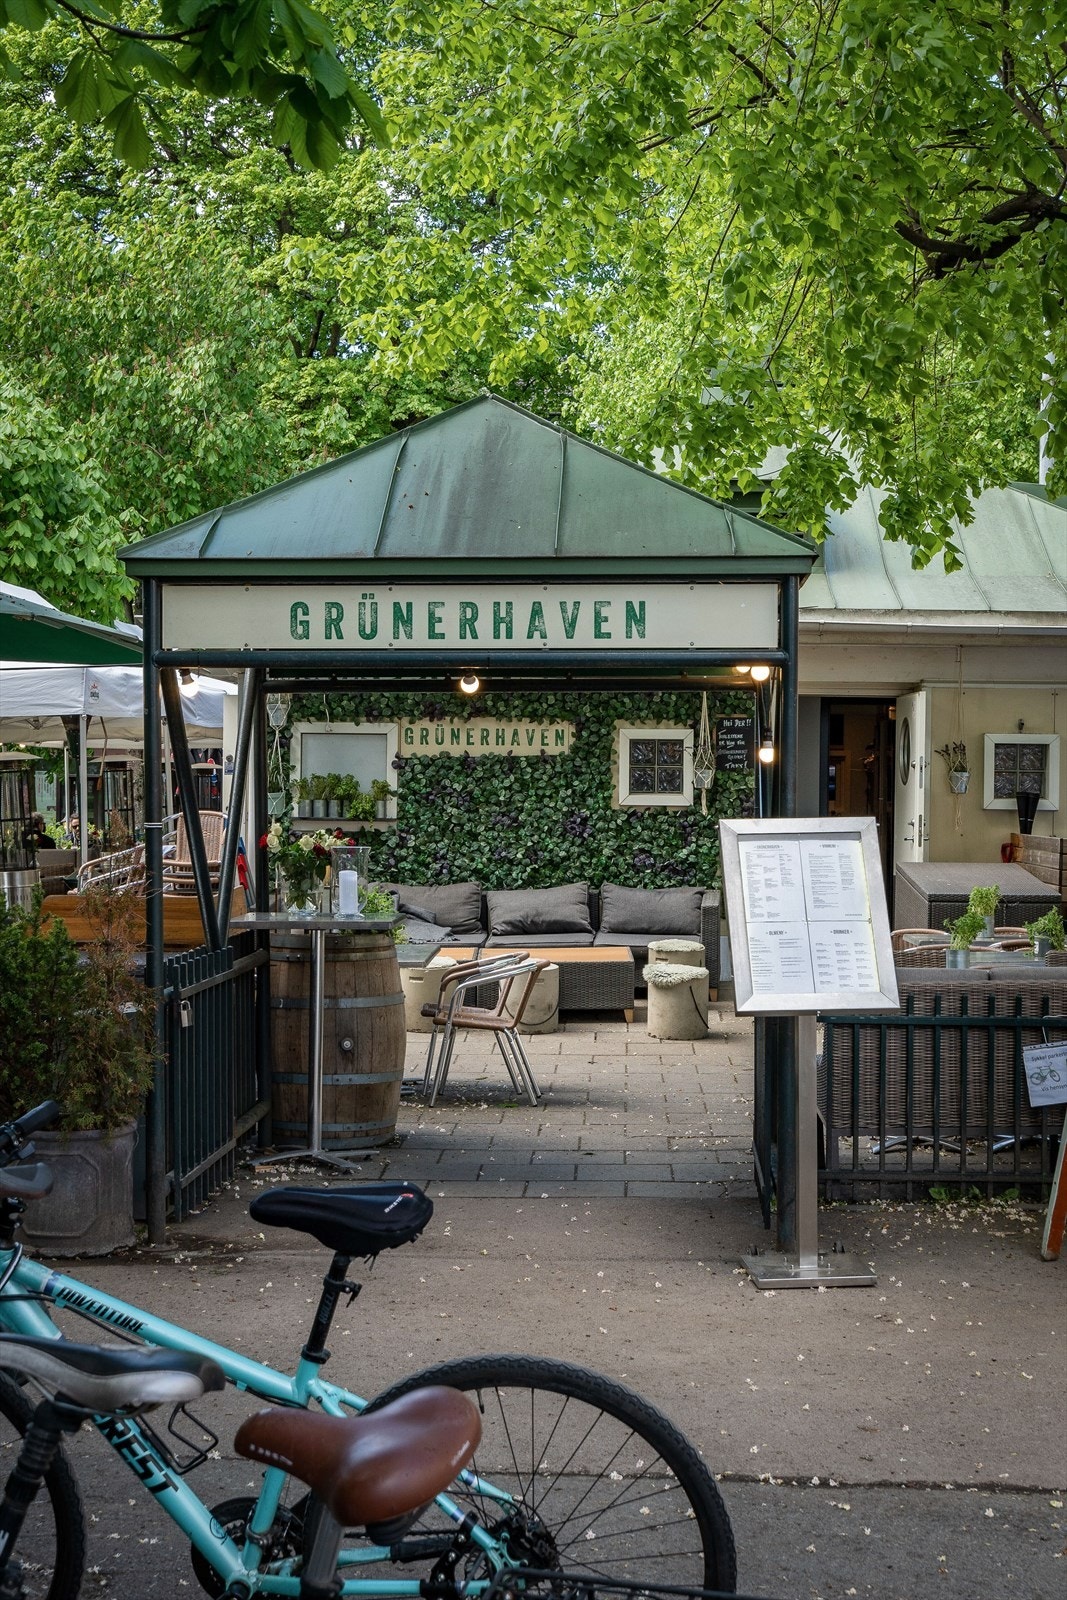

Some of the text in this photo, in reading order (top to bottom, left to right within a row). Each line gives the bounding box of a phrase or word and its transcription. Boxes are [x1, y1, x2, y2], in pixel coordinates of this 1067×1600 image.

[290, 593, 646, 640] GRÜNERHAVEN
[404, 724, 565, 746] GRÜNERHAVEN
[56, 1286, 148, 1333] ADVENTURE
[93, 1414, 180, 1494] REST
